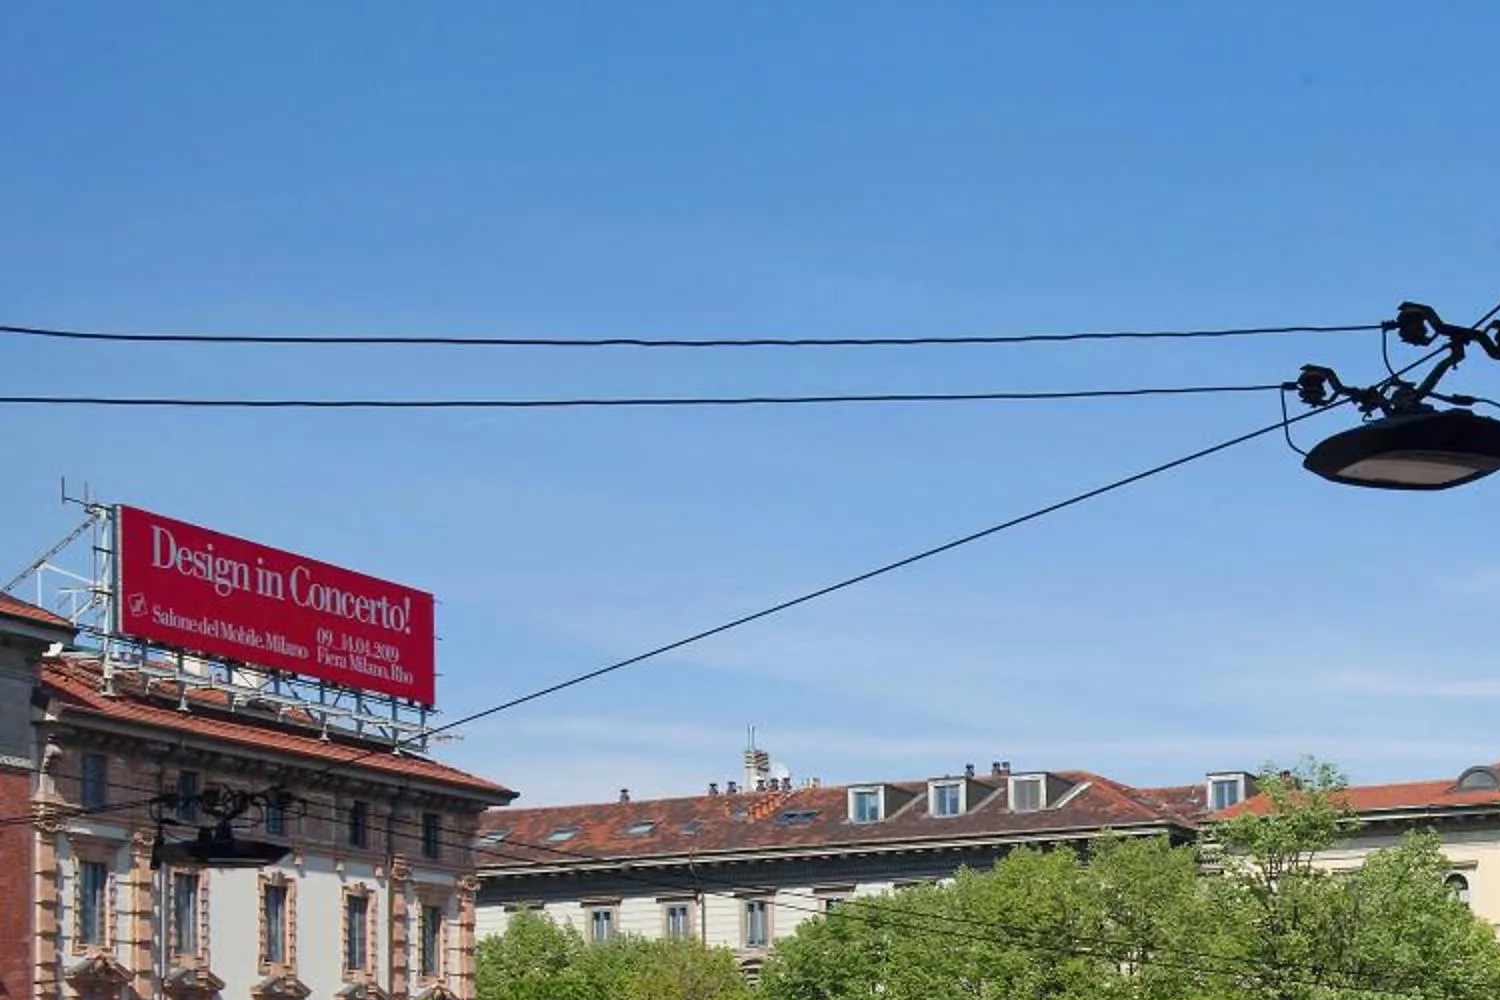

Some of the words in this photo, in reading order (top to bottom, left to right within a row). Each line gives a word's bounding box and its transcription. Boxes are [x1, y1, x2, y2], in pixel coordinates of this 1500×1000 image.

[152, 525, 250, 596] Design
[256, 557, 285, 601] in
[290, 566, 411, 635] Concerto!
[152, 604, 199, 631] Salone
[199, 618, 220, 638] del
[316, 649, 348, 669] Fiera
